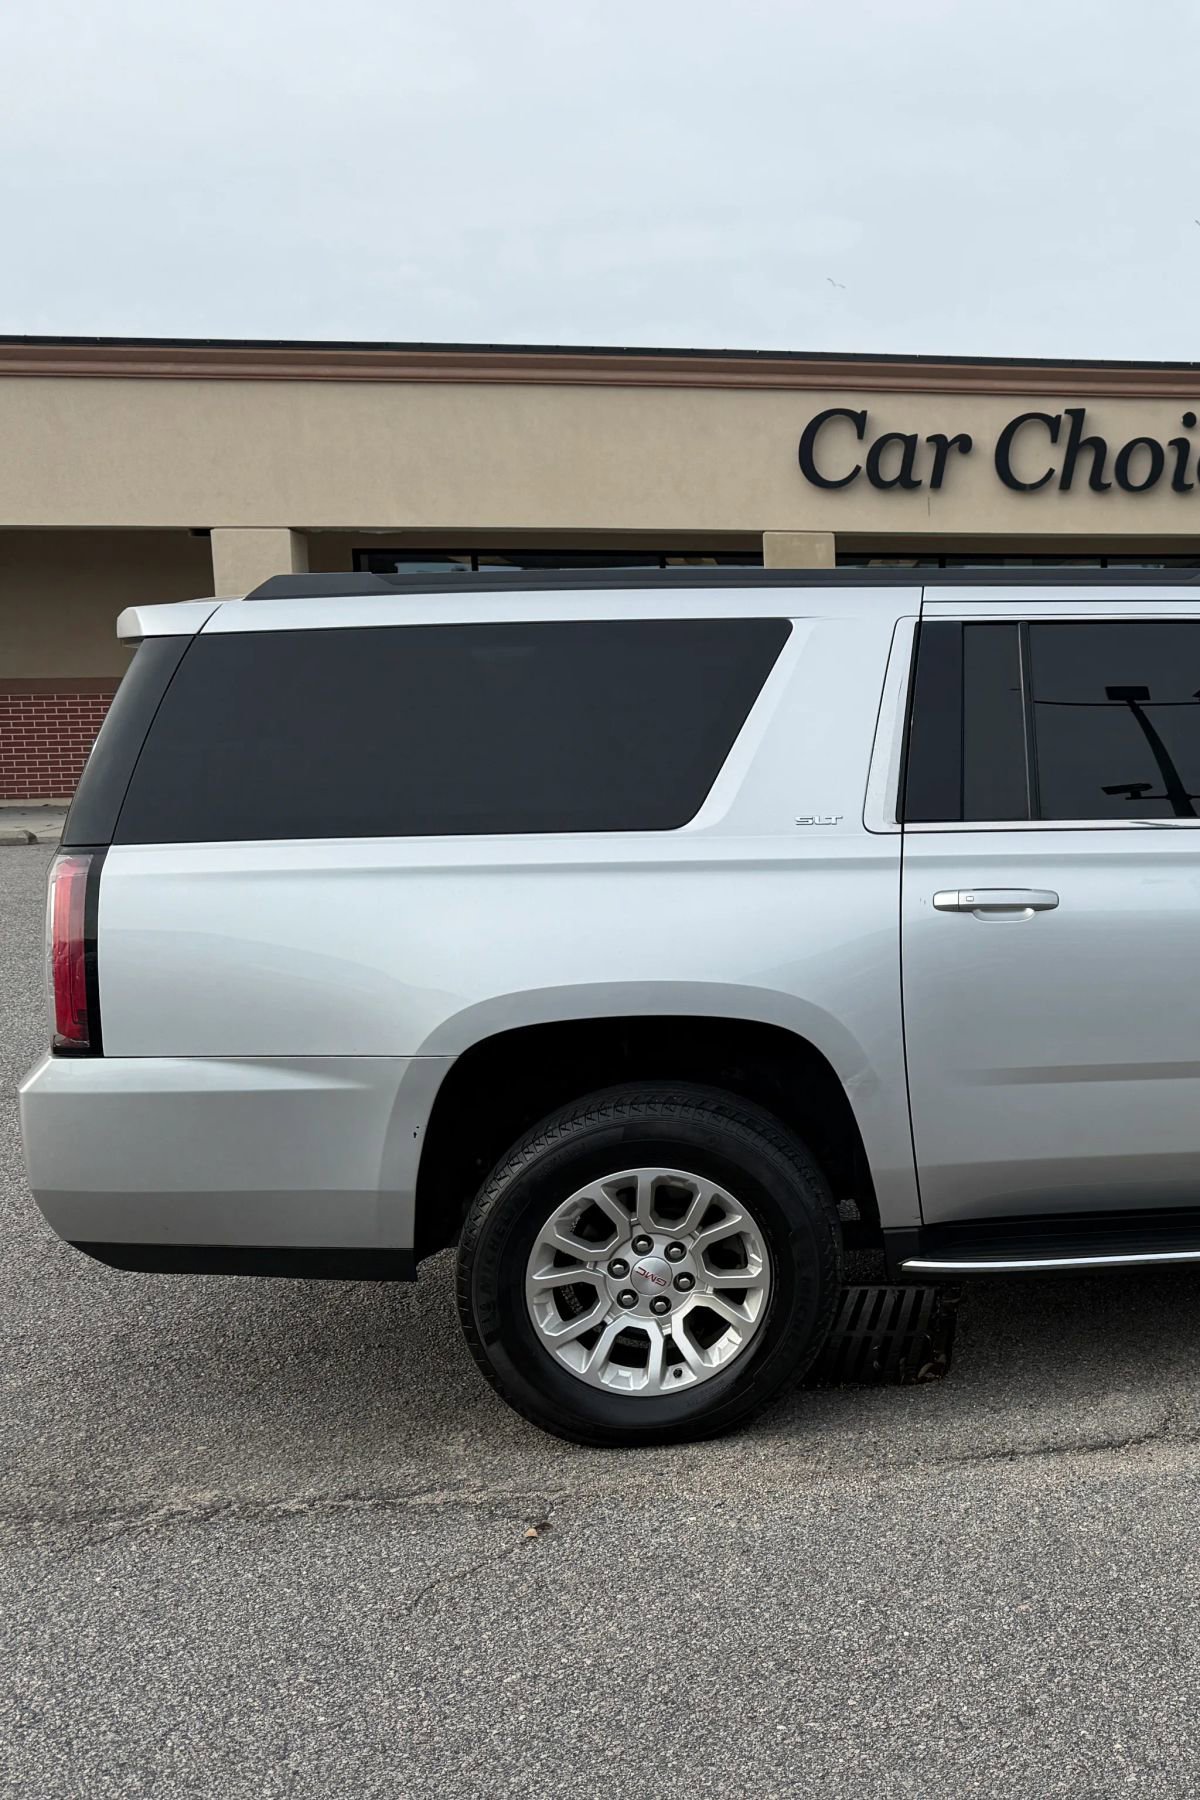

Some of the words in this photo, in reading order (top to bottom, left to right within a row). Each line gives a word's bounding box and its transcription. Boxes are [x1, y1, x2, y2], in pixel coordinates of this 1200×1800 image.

[798, 407, 972, 490] Car
[794, 815, 843, 826] SLT
[635, 1266, 667, 1287] GMC
